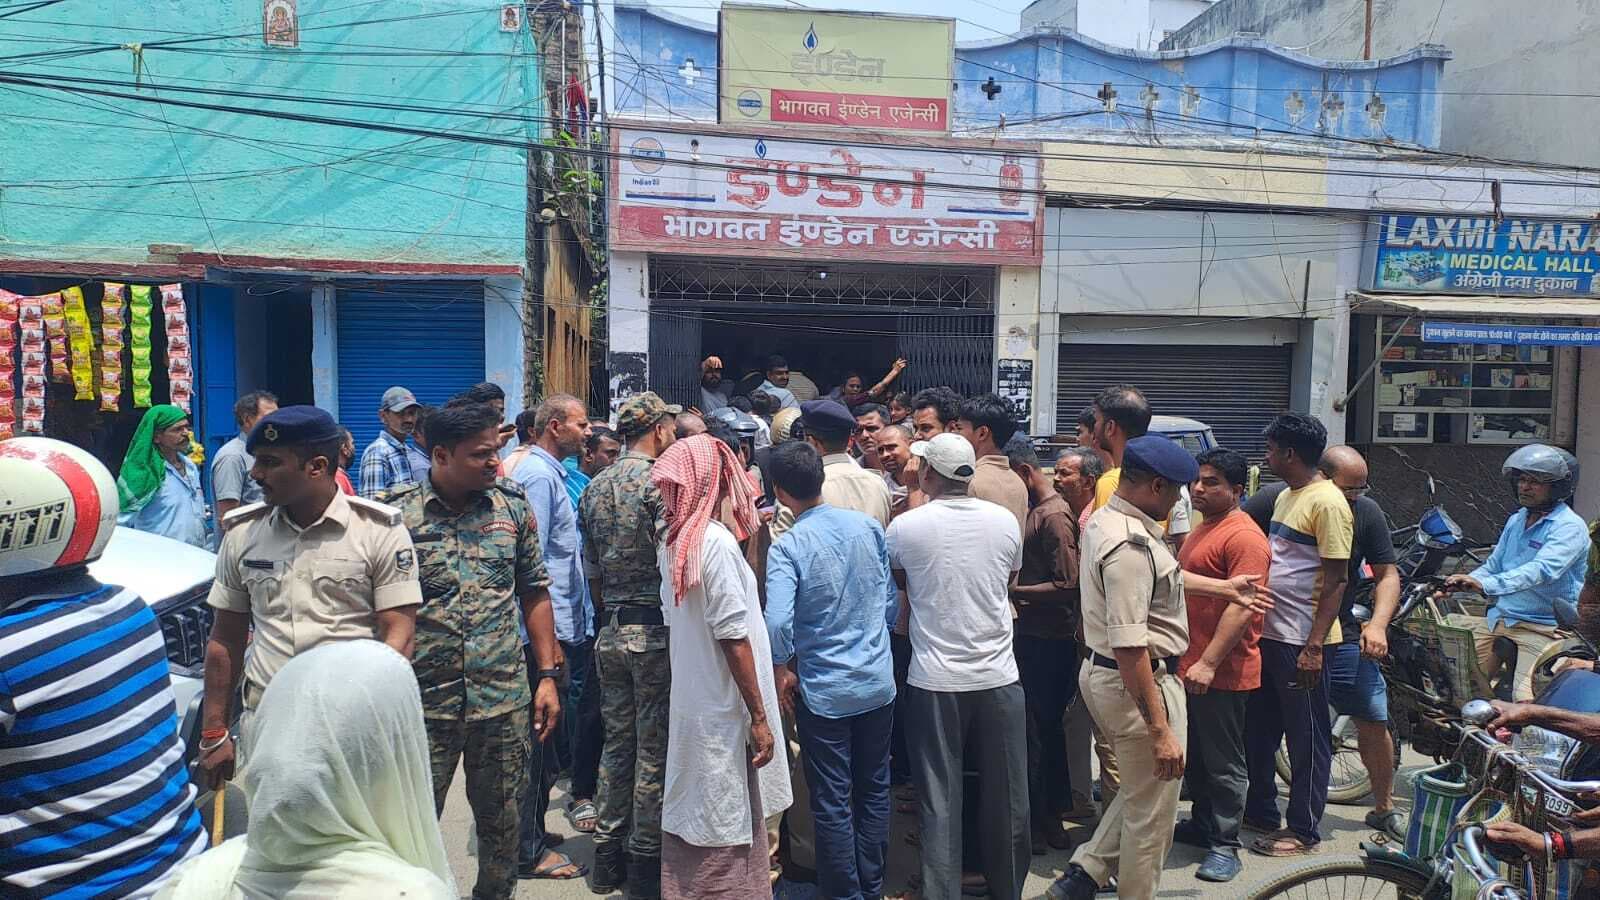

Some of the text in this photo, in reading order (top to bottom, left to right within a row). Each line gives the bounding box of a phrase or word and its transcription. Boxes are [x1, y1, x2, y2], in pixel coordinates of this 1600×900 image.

[778, 99, 830, 117] भागवत
[888, 102, 939, 122] एजेन्सी
[663, 215, 770, 241] भागवत
[887, 218, 999, 249] एजेन्सी
[1386, 215, 1498, 250] LAXMI
[1450, 253, 1595, 273] MEDICAL HALL
[1454, 270, 1578, 294] अंग्रेजी दवा दुकान
